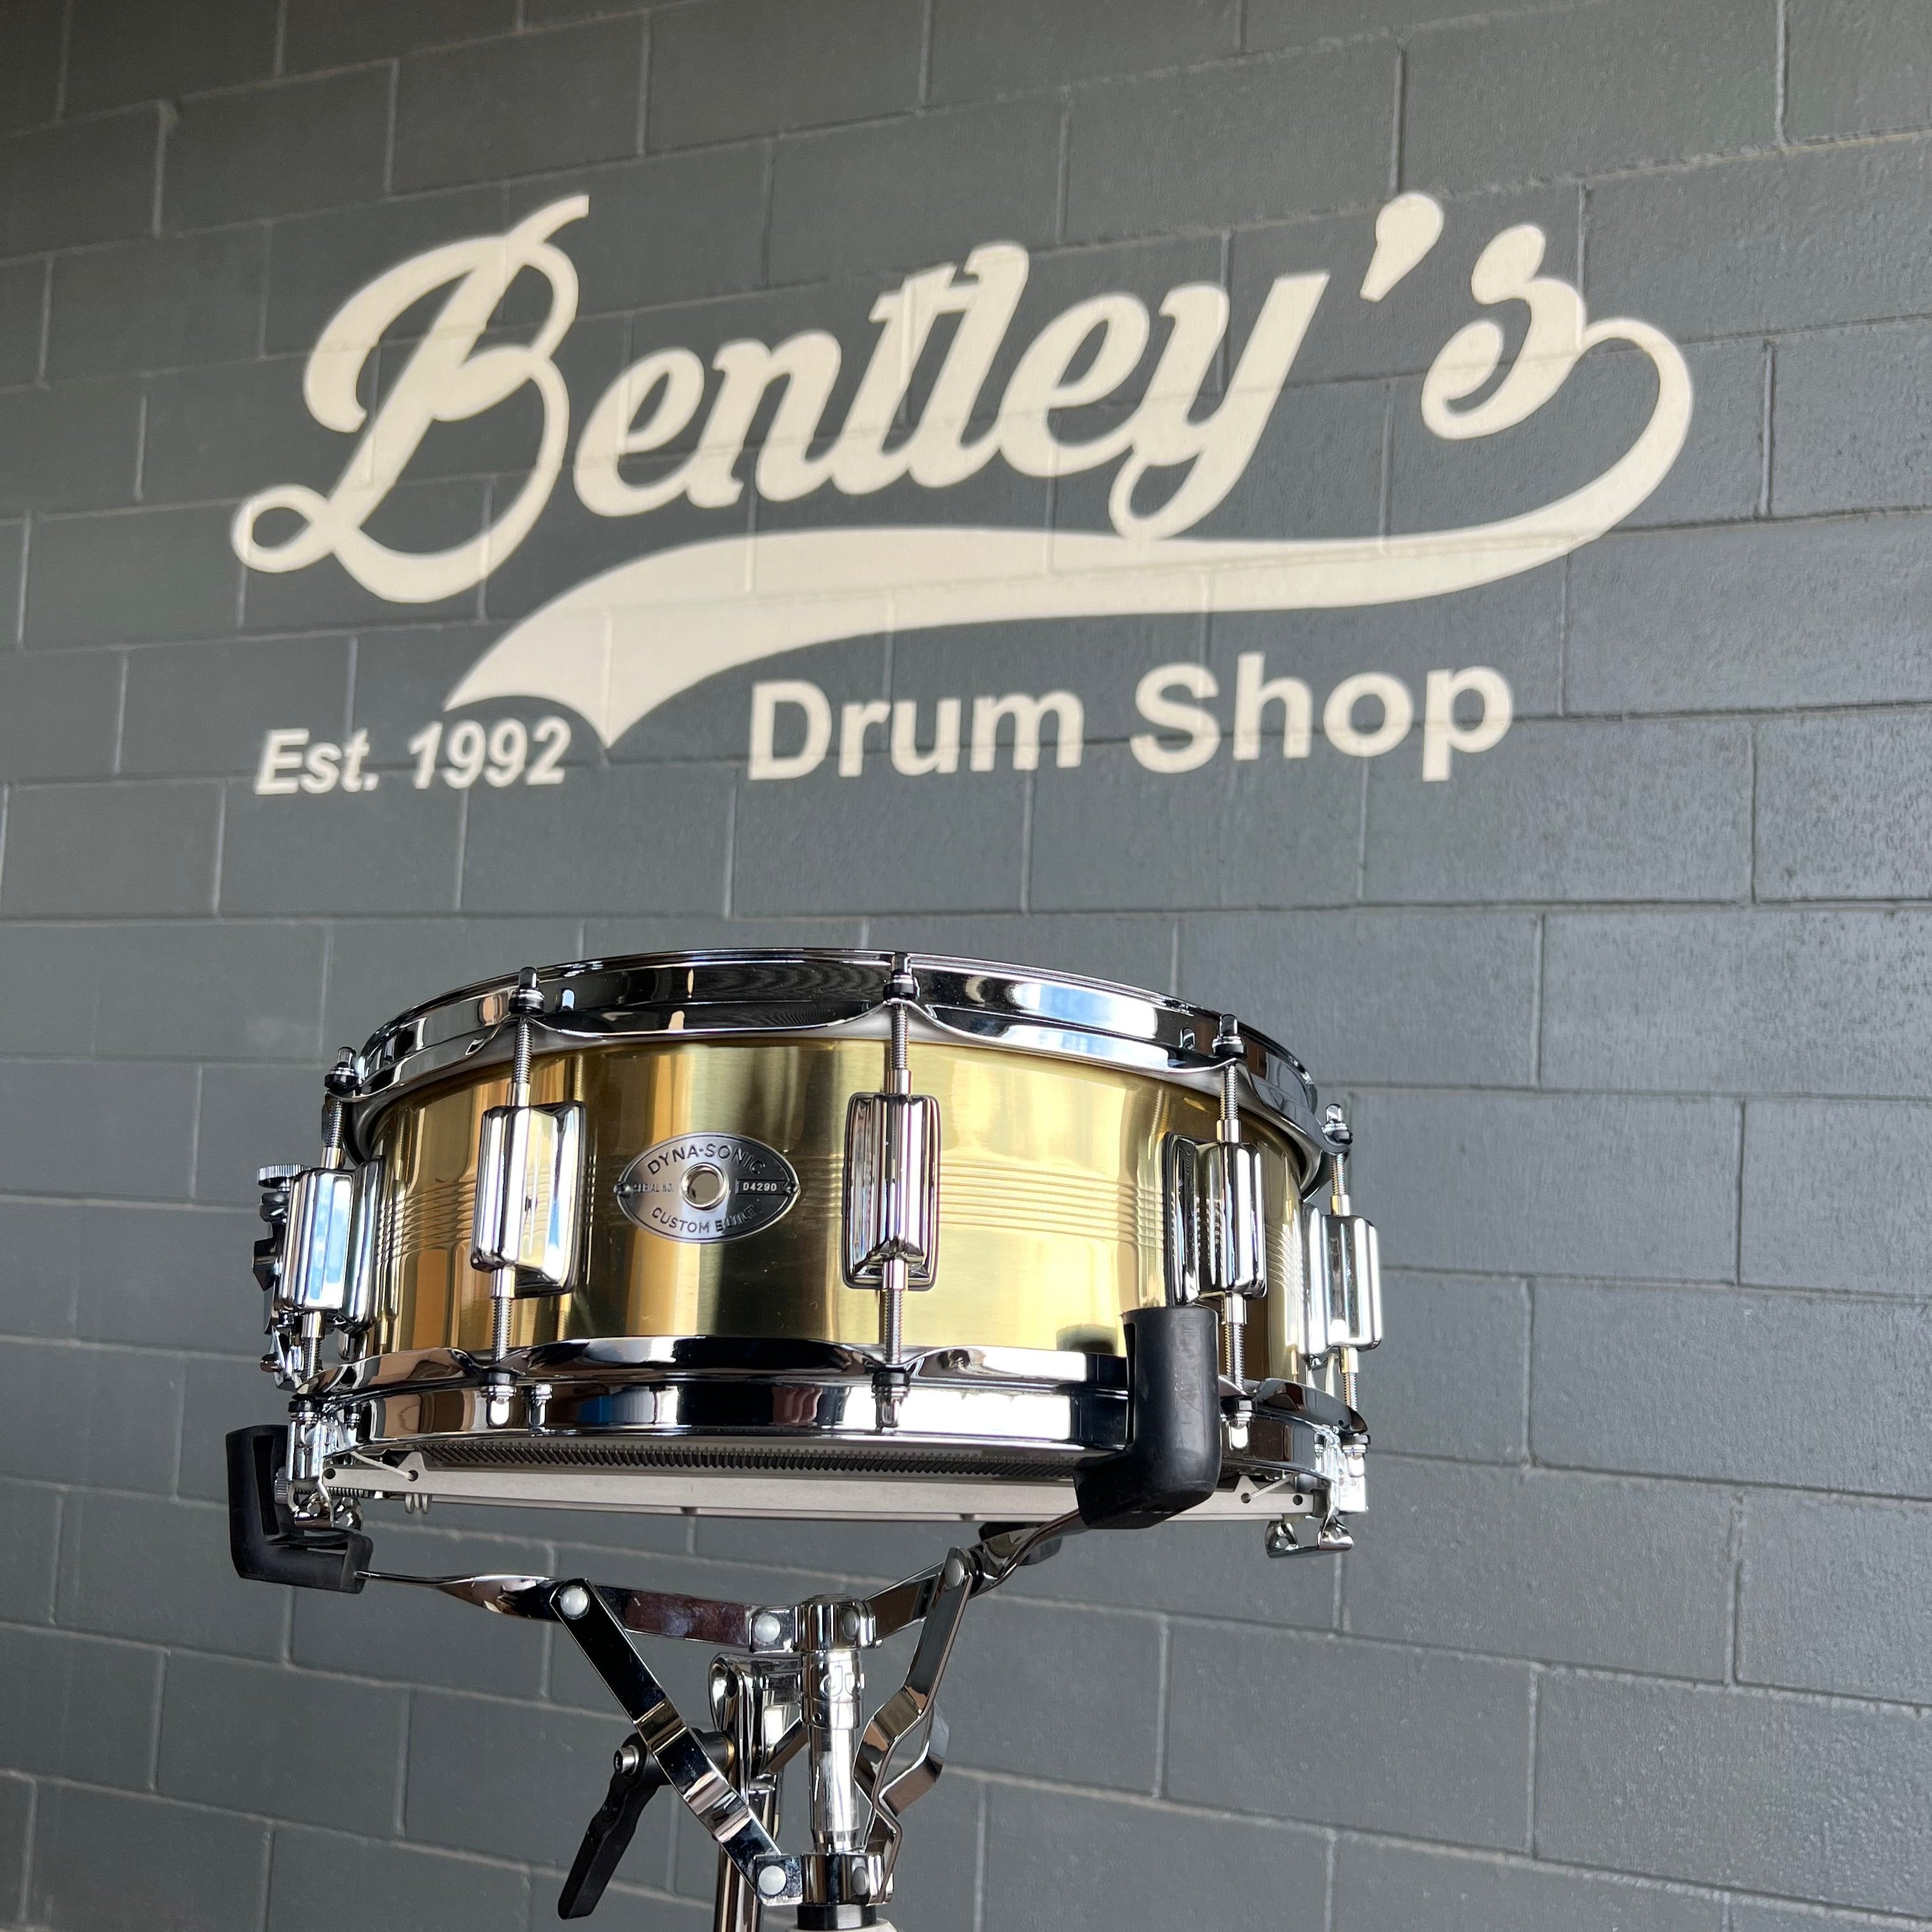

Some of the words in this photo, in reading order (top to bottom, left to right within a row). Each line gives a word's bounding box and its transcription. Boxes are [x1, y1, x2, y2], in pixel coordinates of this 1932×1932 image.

[231, 192, 1597, 604] Bentley's
[254, 728, 379, 795] Est.
[409, 717, 571, 790] 1992
[747, 681, 1085, 782] Drum
[1131, 652, 1514, 783] Shop
[647, 1142, 766, 1176] DYNA-SONIC
[651, 1207, 710, 1234] CUSTOM
[715, 1205, 756, 1232] BUILT
